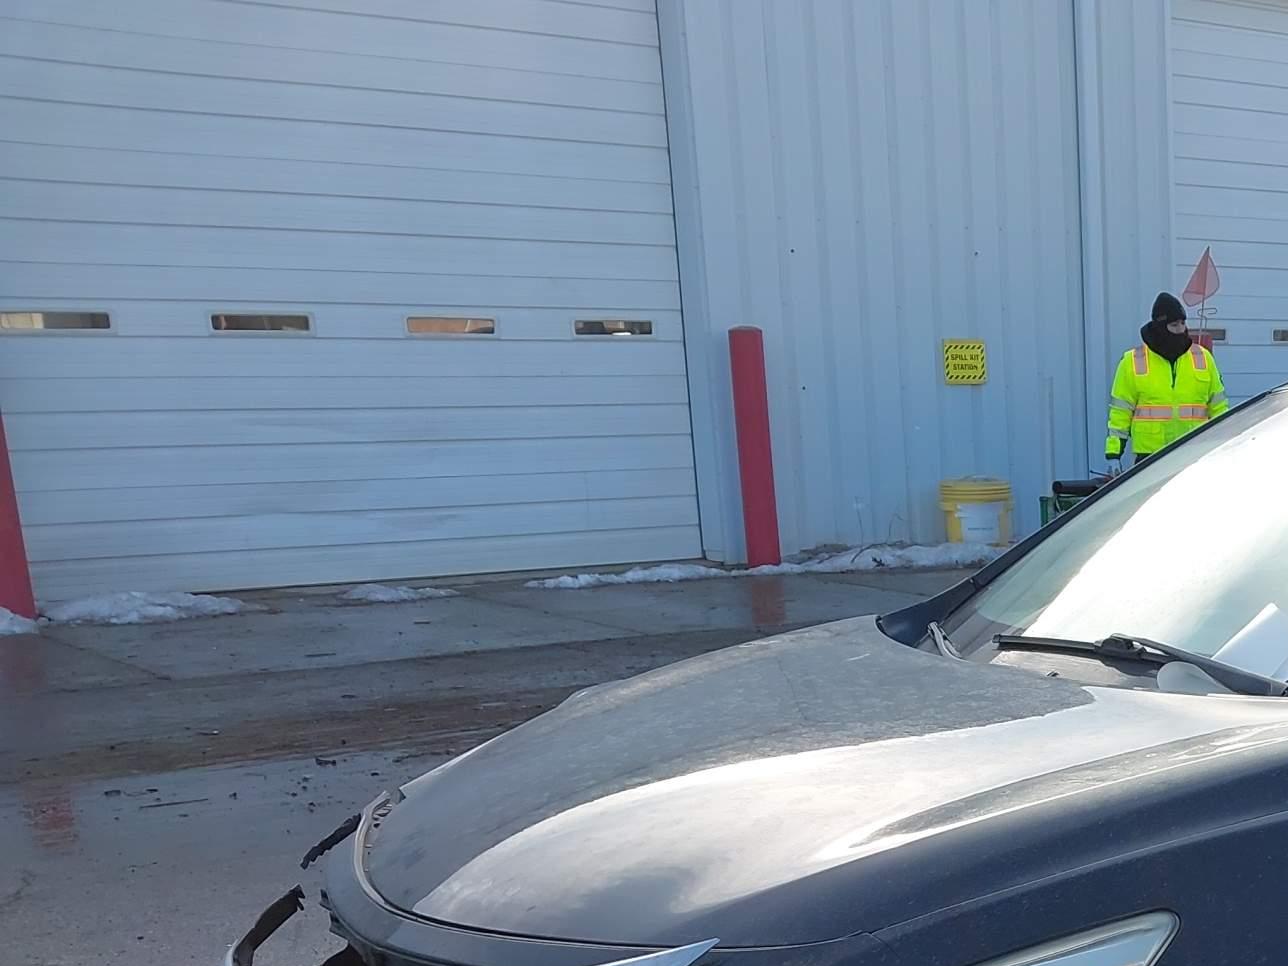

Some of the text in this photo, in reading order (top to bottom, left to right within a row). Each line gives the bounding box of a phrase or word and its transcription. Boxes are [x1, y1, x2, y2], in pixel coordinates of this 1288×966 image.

[950, 353, 979, 361] SPILL KIT
[952, 363, 978, 371] STATION
